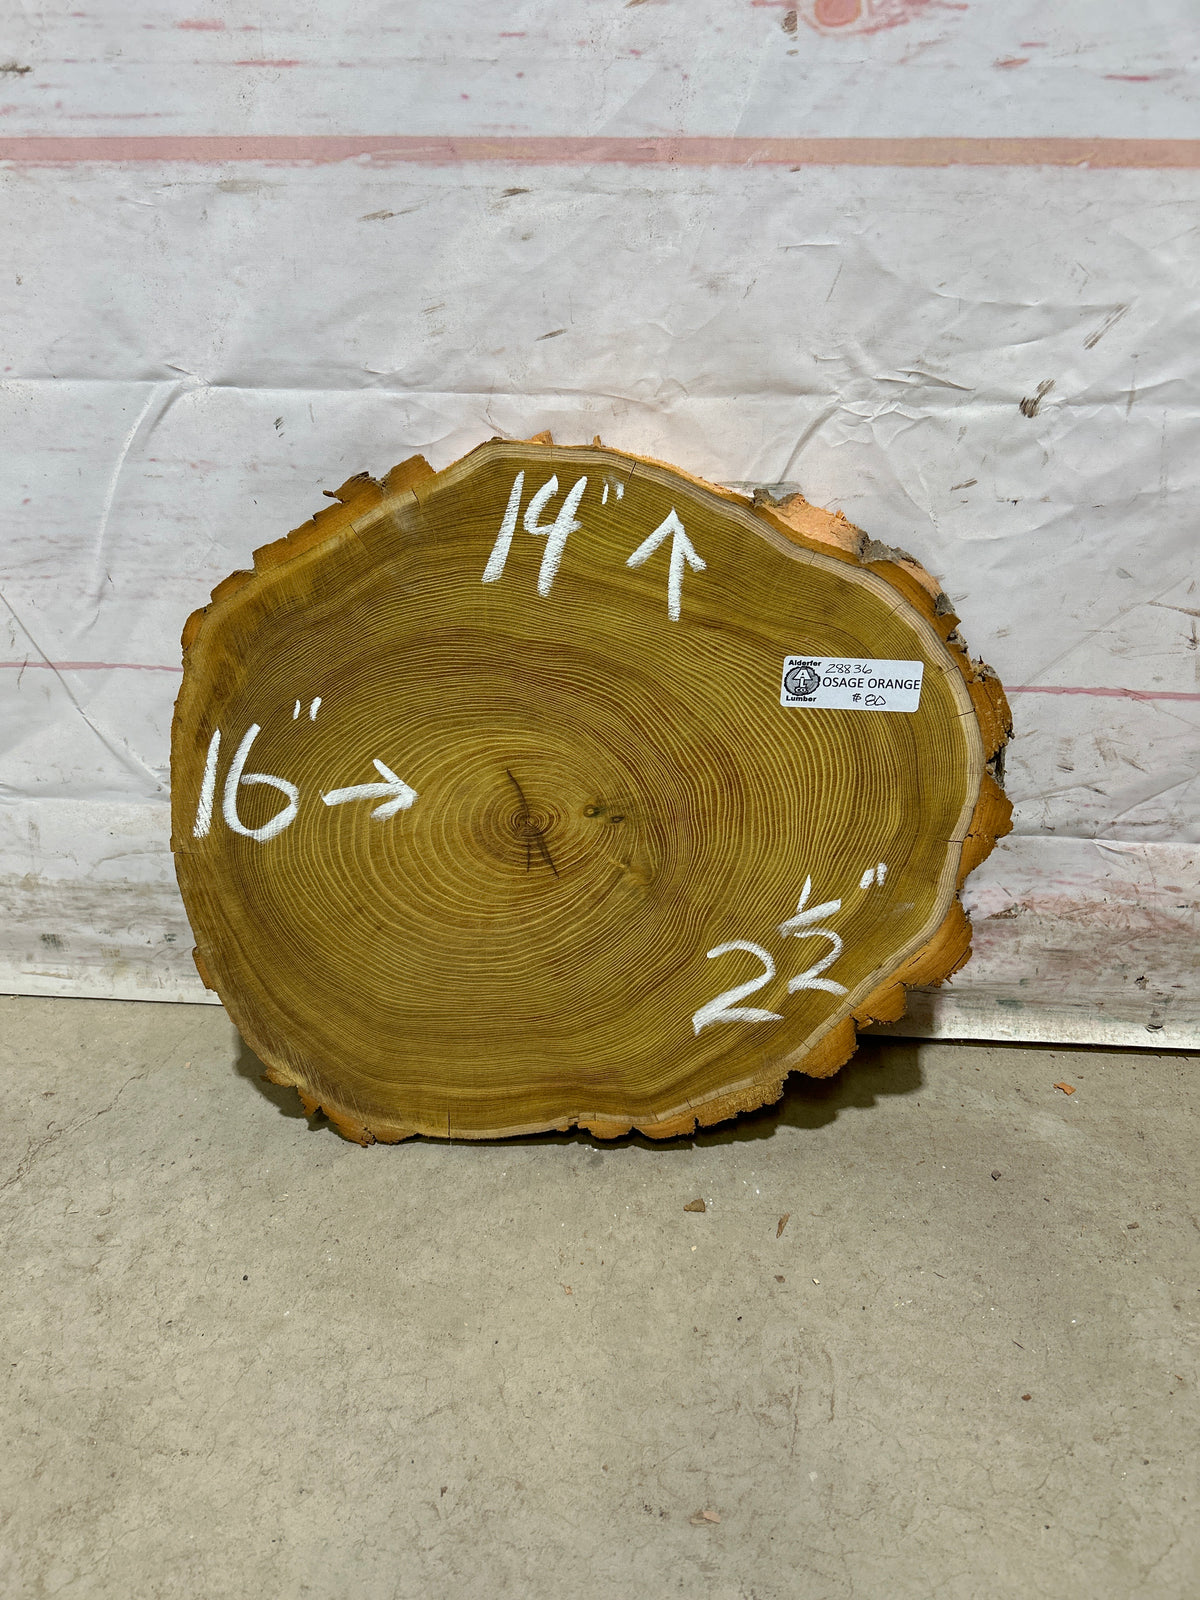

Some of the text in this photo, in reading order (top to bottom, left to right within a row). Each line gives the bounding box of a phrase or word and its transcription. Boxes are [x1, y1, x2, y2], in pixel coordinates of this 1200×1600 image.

[481, 470, 625, 597] 14"
[788, 659, 822, 667] Alderfer
[825, 663, 873, 674] 28836
[822, 677, 921, 690] OSAGE ORANGE
[193, 696, 322, 843] 16"
